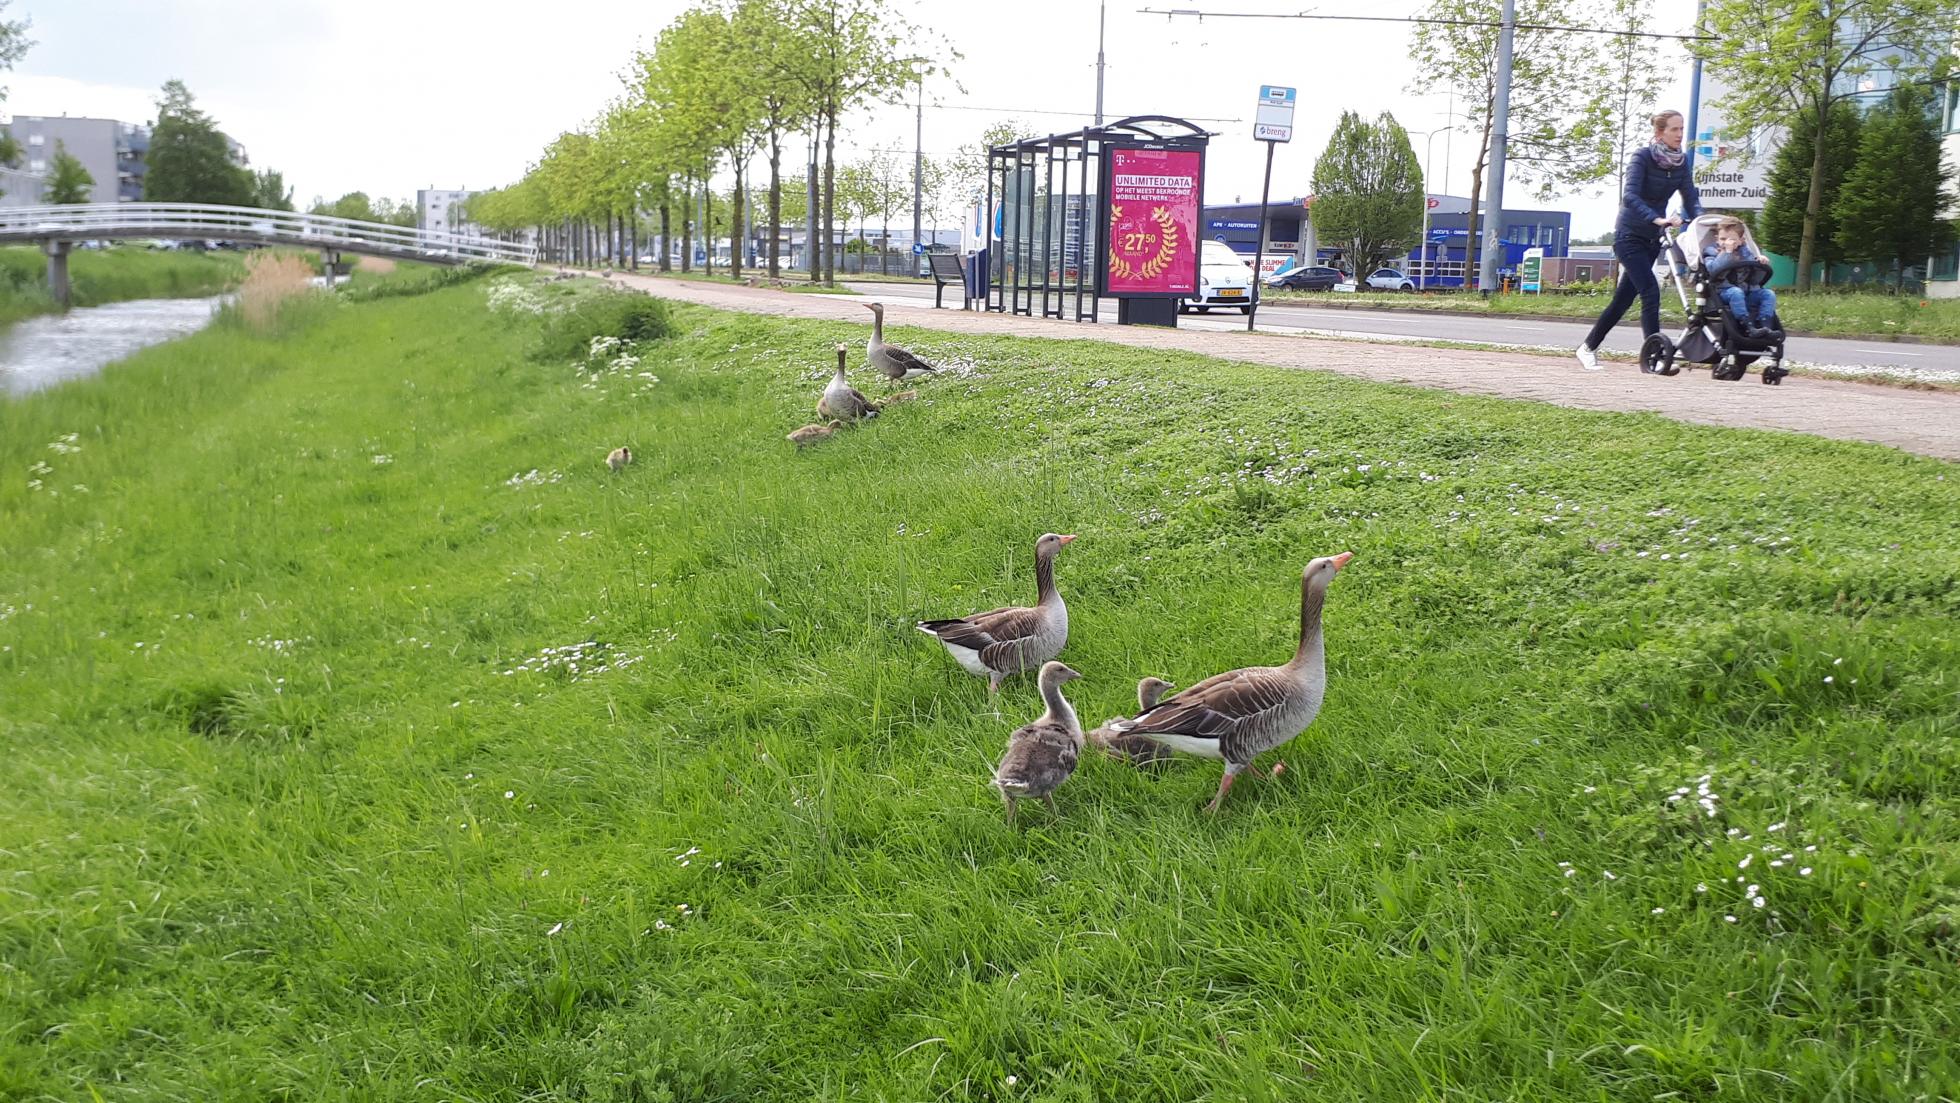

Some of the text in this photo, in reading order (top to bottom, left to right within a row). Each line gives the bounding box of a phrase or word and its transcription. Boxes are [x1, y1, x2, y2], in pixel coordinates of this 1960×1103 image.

[1266, 127, 1286, 138] breng
[1117, 176, 1190, 187] UNLIMITED DATA
[1699, 187, 1766, 198] rnhem-Zuid
